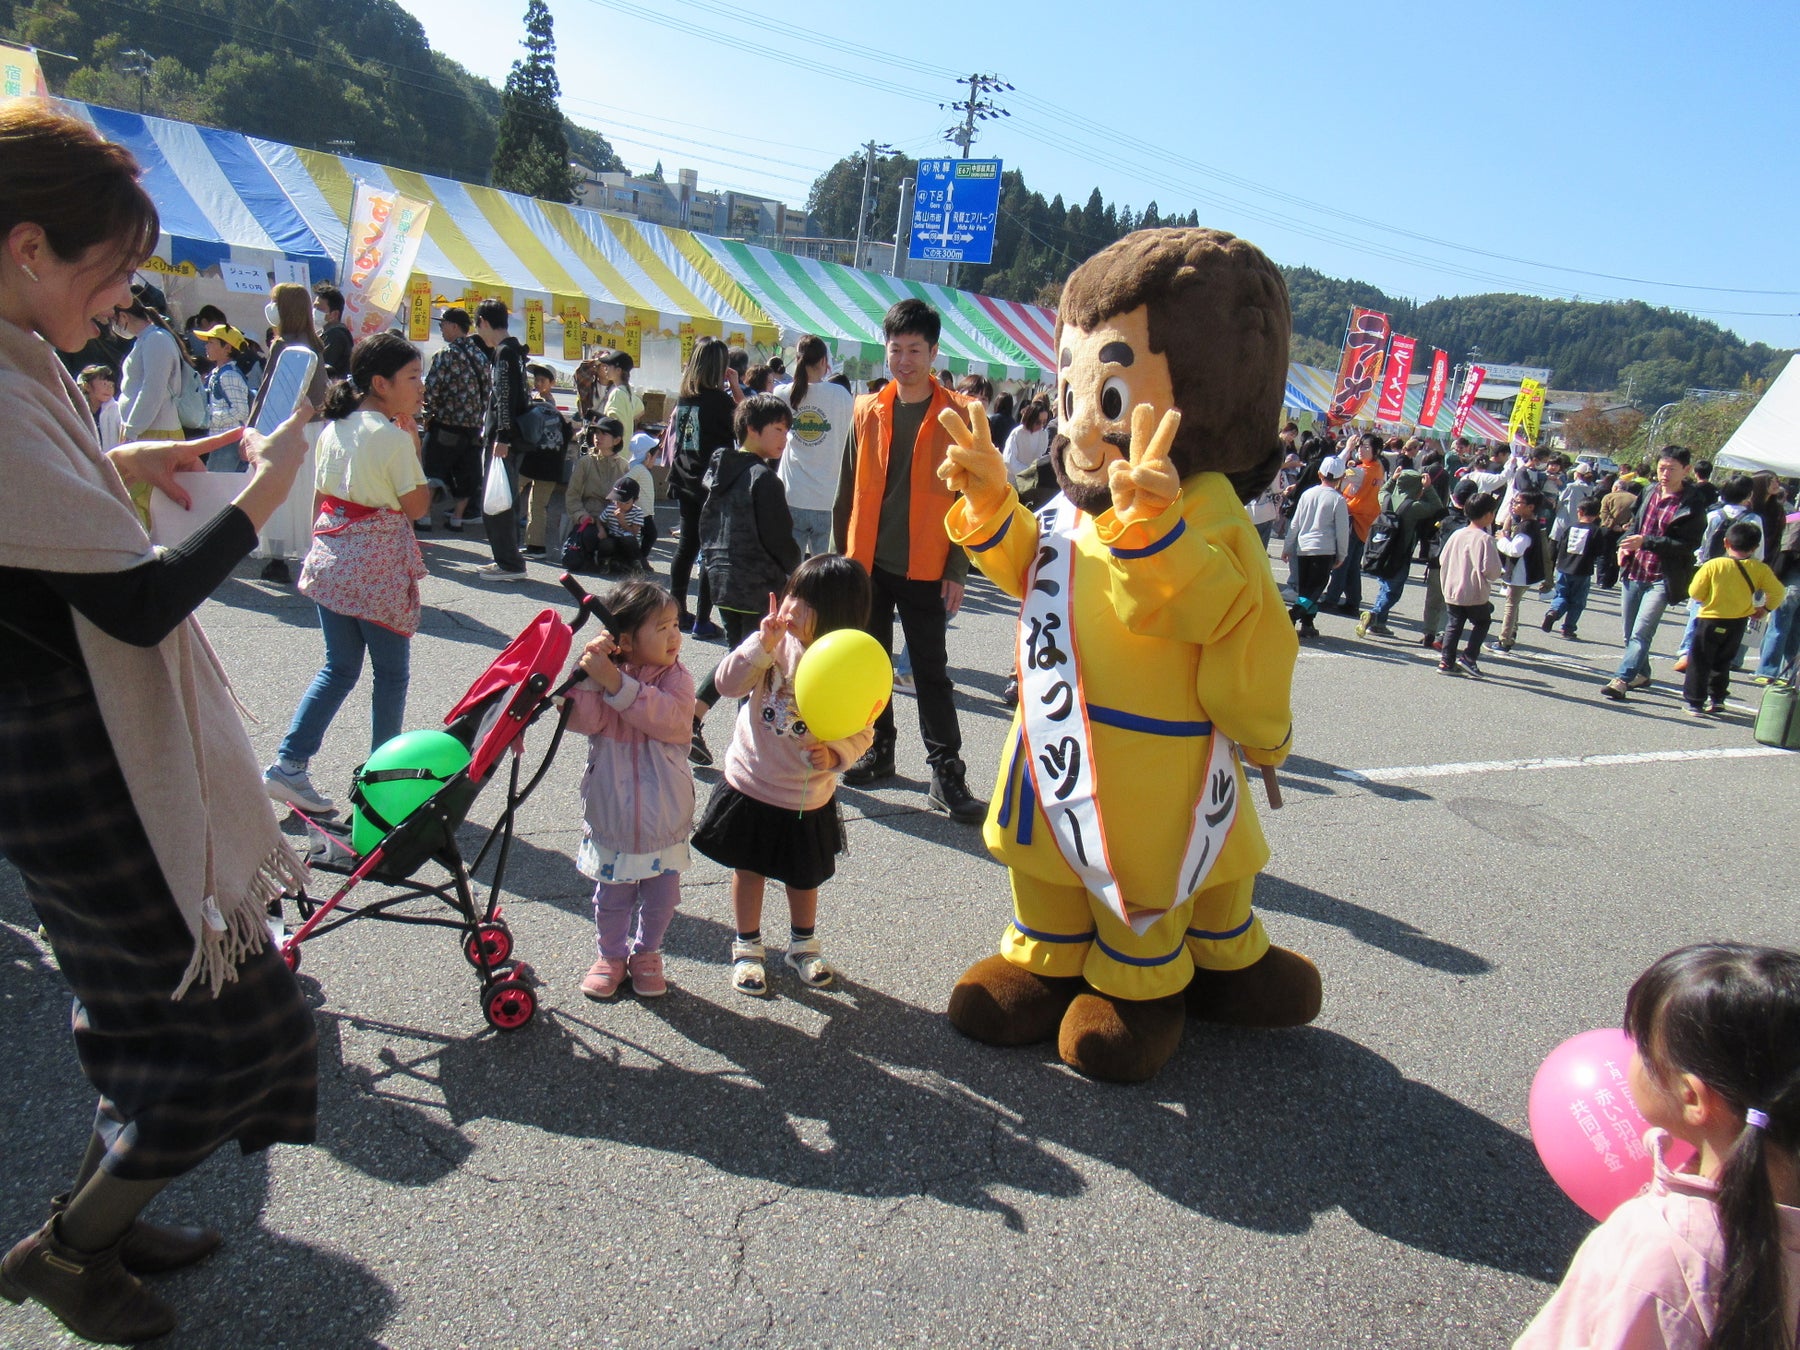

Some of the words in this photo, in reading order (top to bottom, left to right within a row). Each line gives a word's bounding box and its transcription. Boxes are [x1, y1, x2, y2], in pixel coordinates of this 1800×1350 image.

[932, 162, 950, 173] 飛騨
[957, 167, 970, 175] E67
[929, 190, 944, 202] 下呂
[953, 211, 994, 224] 飛騨エアパーク
[924, 248, 963, 259] この先300m
[230, 267, 260, 277] ジュース
[235, 282, 263, 291] 150円
[1385, 349, 1410, 409] ラーメン
[1594, 1088, 1649, 1162] 赤い羽根
[1569, 1099, 1624, 1173] 共同募金
